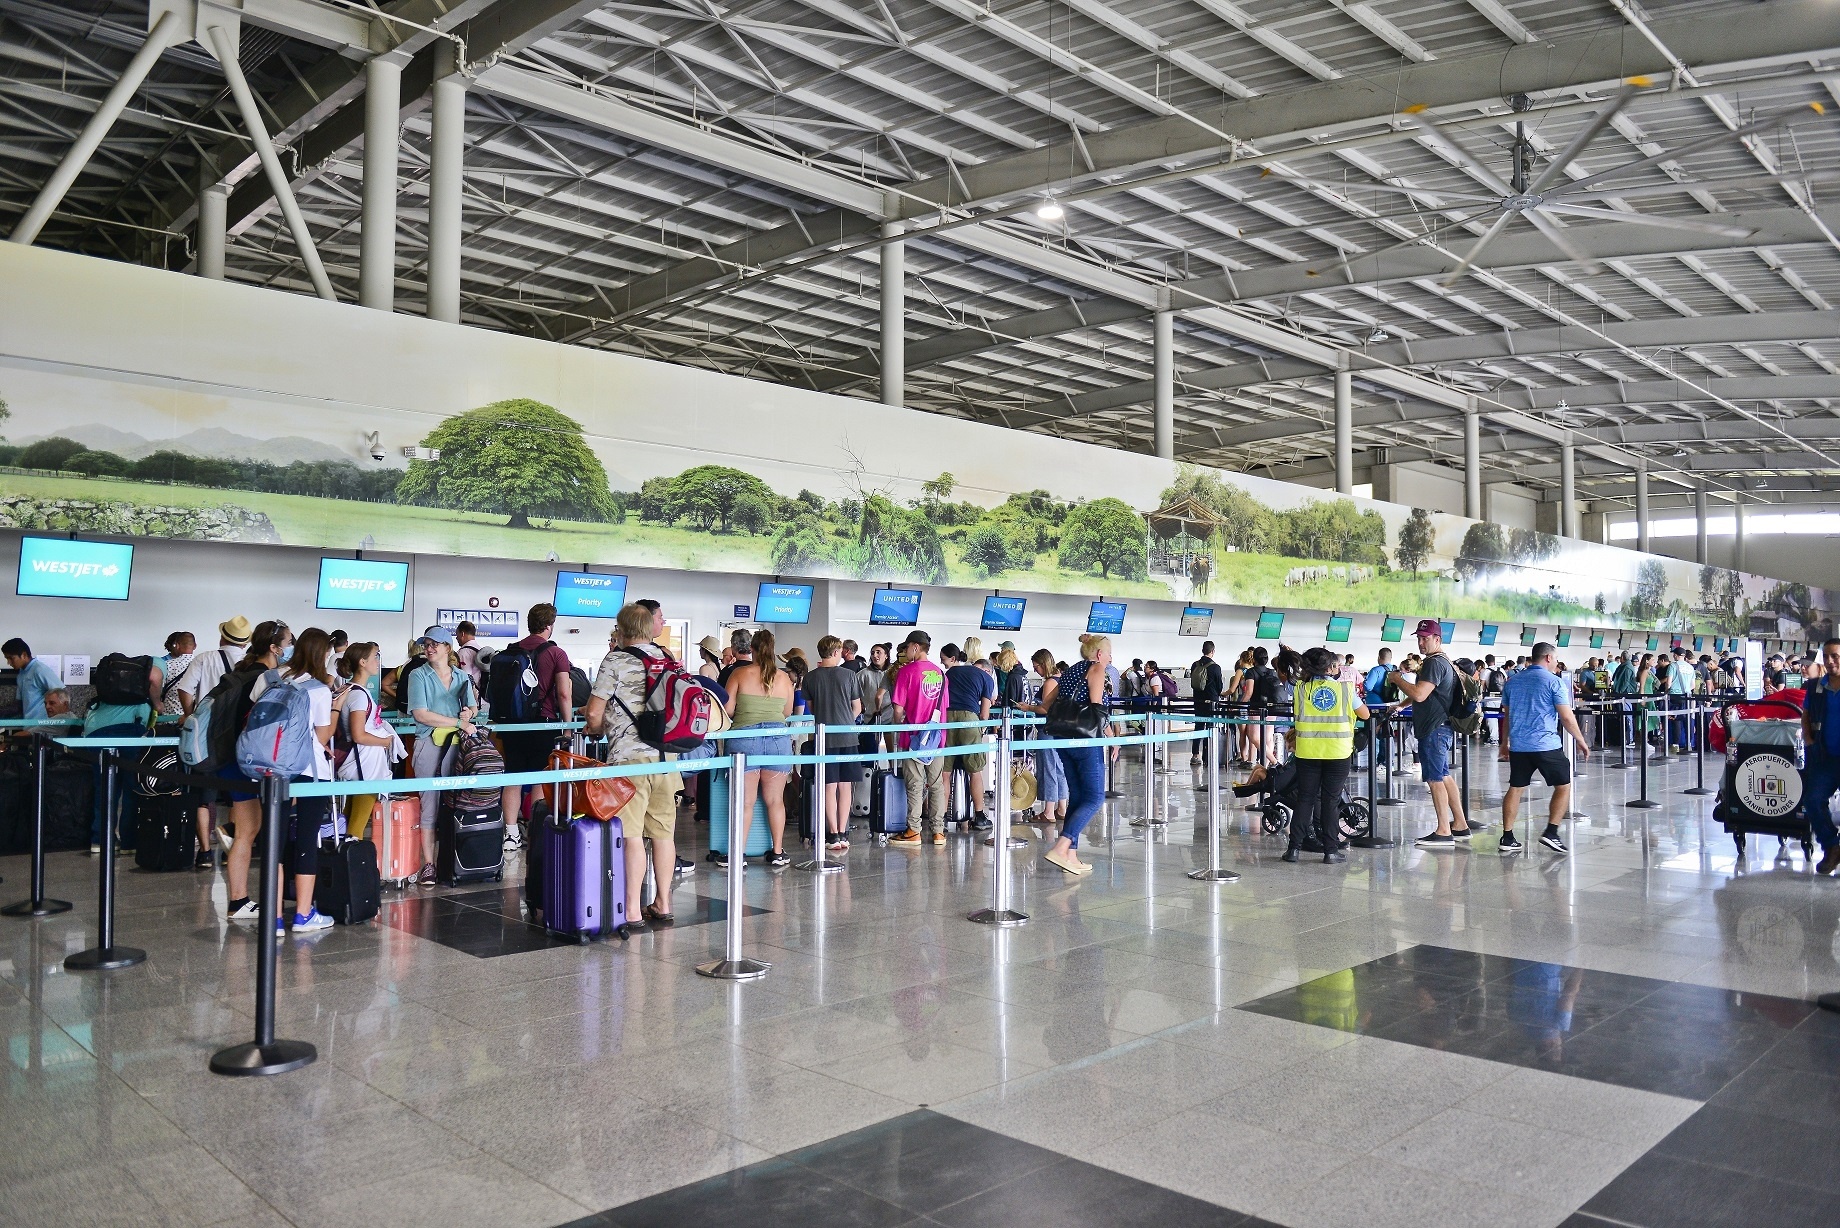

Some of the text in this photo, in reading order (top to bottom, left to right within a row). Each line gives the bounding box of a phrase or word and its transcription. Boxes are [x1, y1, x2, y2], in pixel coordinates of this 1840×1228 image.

[32, 560, 102, 578] WESTJET
[329, 578, 384, 592] WESTJET
[574, 577, 604, 587] WESTJET
[772, 588, 796, 596] WESTJET
[578, 598, 602, 608] Priority
[774, 606, 793, 615] Priority
[675, 762, 702, 770] WESTJET
[1745, 755, 1791, 769] AEROPUERTO
[563, 769, 595, 779] WESTJET
[432, 779, 468, 788] WESTJET
[1743, 795, 1795, 815] DANIEL ODUBER
[1765, 798, 1777, 807] 10
